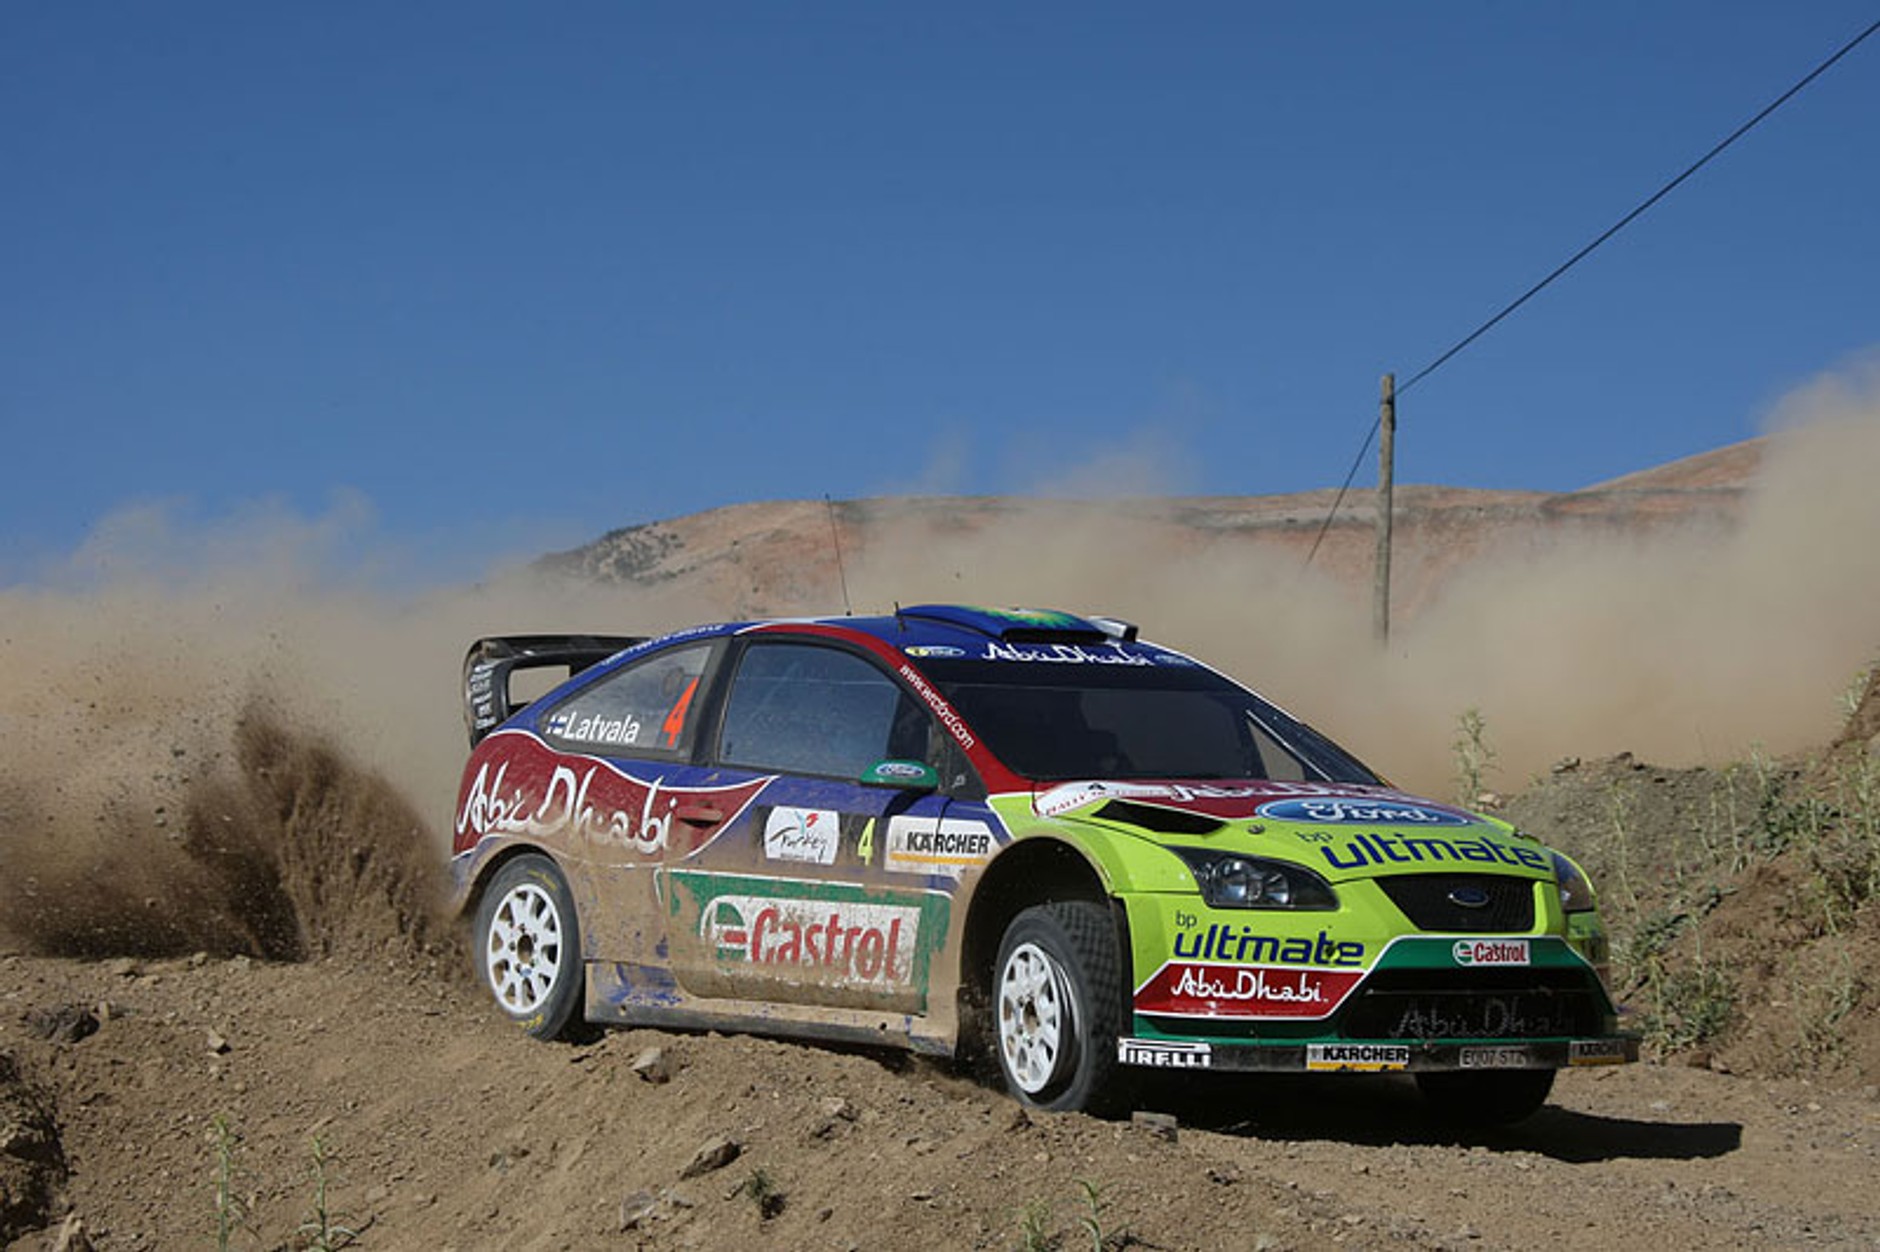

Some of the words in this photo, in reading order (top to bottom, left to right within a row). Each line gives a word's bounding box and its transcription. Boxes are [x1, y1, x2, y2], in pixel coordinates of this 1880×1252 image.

[564, 711, 640, 744] Latvala
[663, 676, 699, 747] 4
[1302, 801, 1438, 821] Ford
[858, 818, 876, 866] 4
[1320, 833, 1550, 871] ultimate
[1175, 911, 1198, 929] bp
[752, 907, 902, 982] Castrol
[1173, 924, 1365, 967] ultimate
[1474, 942, 1526, 962] Castrol
[1118, 1037, 1212, 1068] PIRELLI
